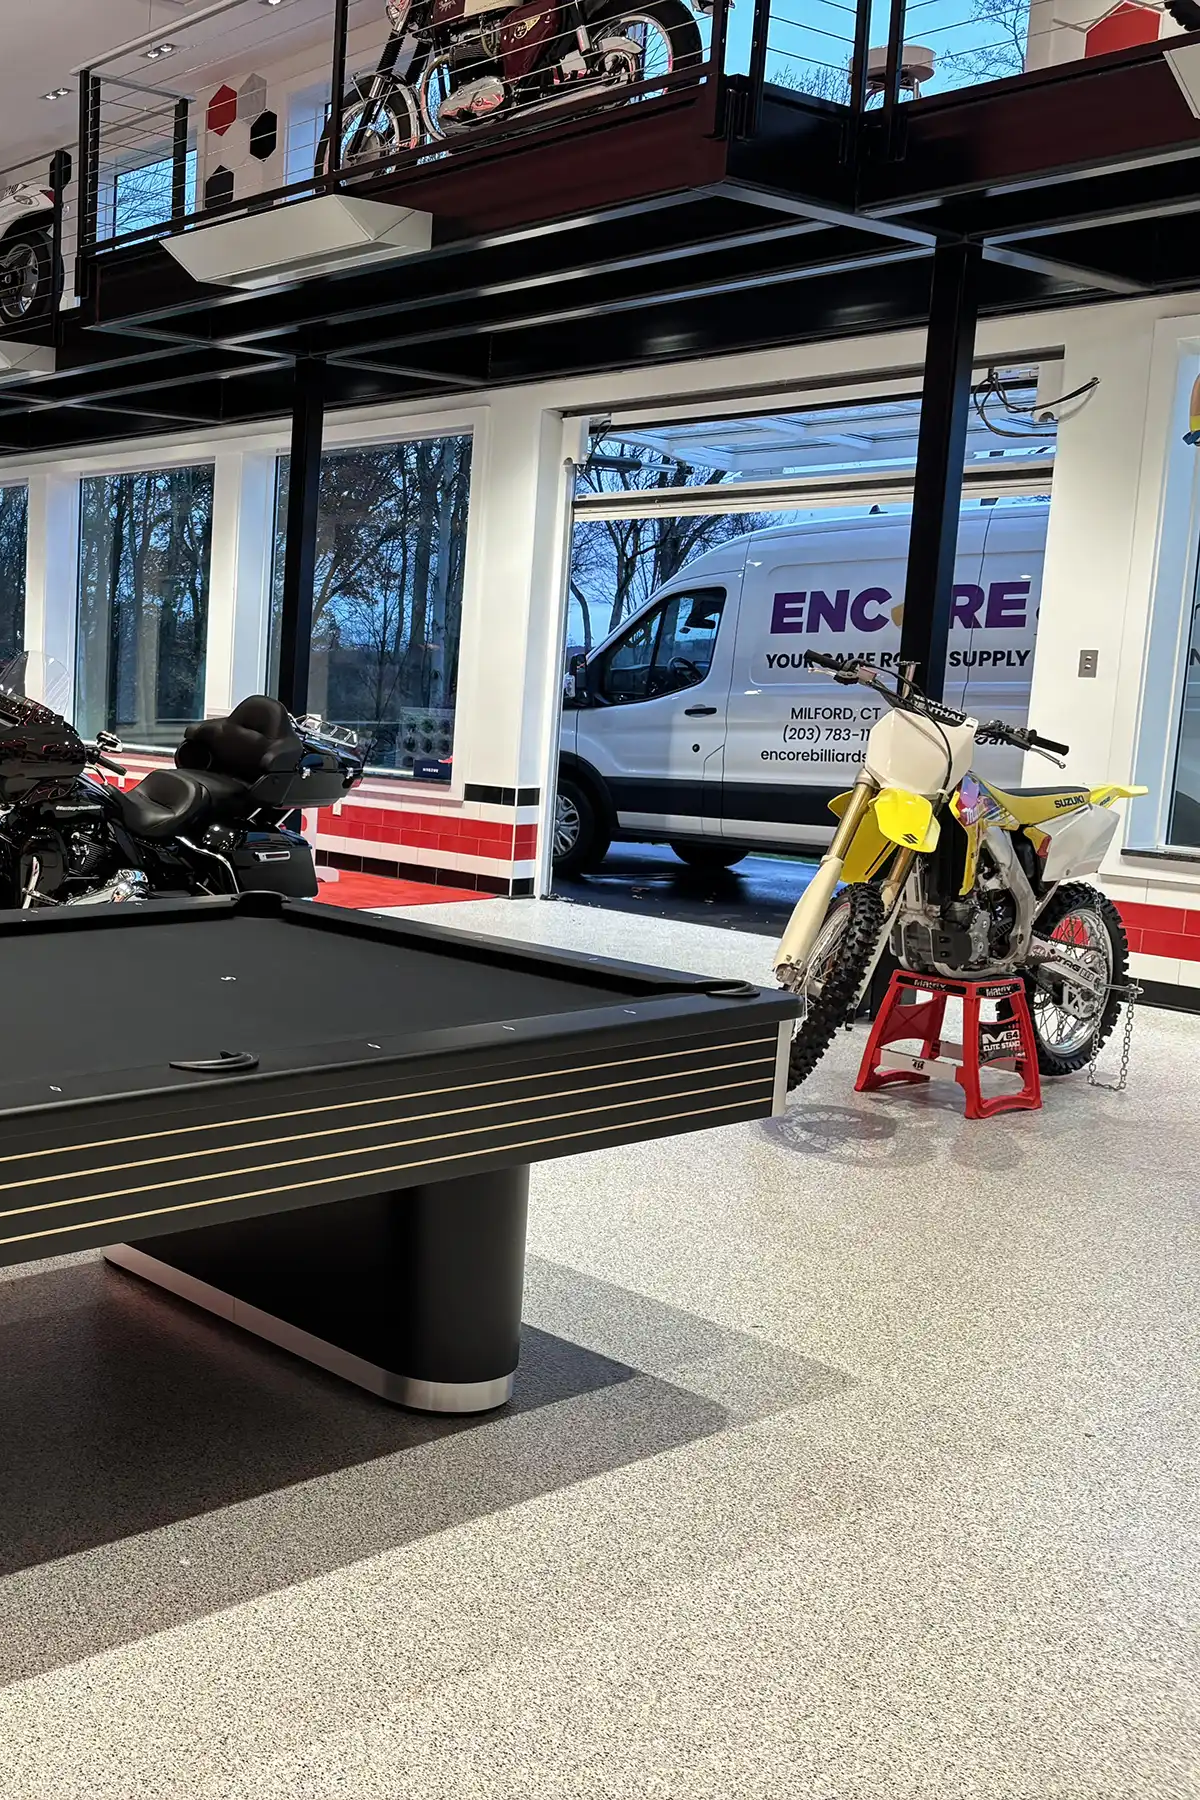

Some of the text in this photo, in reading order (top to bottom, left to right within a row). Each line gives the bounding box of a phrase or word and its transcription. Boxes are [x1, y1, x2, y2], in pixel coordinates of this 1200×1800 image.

[770, 581, 1031, 635] ENCRE
[948, 650, 1031, 668] SUPPLY
[790, 707, 882, 722] MILFORD, CT
[782, 725, 870, 743] (203) 783-11
[1054, 796, 1085, 809] SUZUKI
